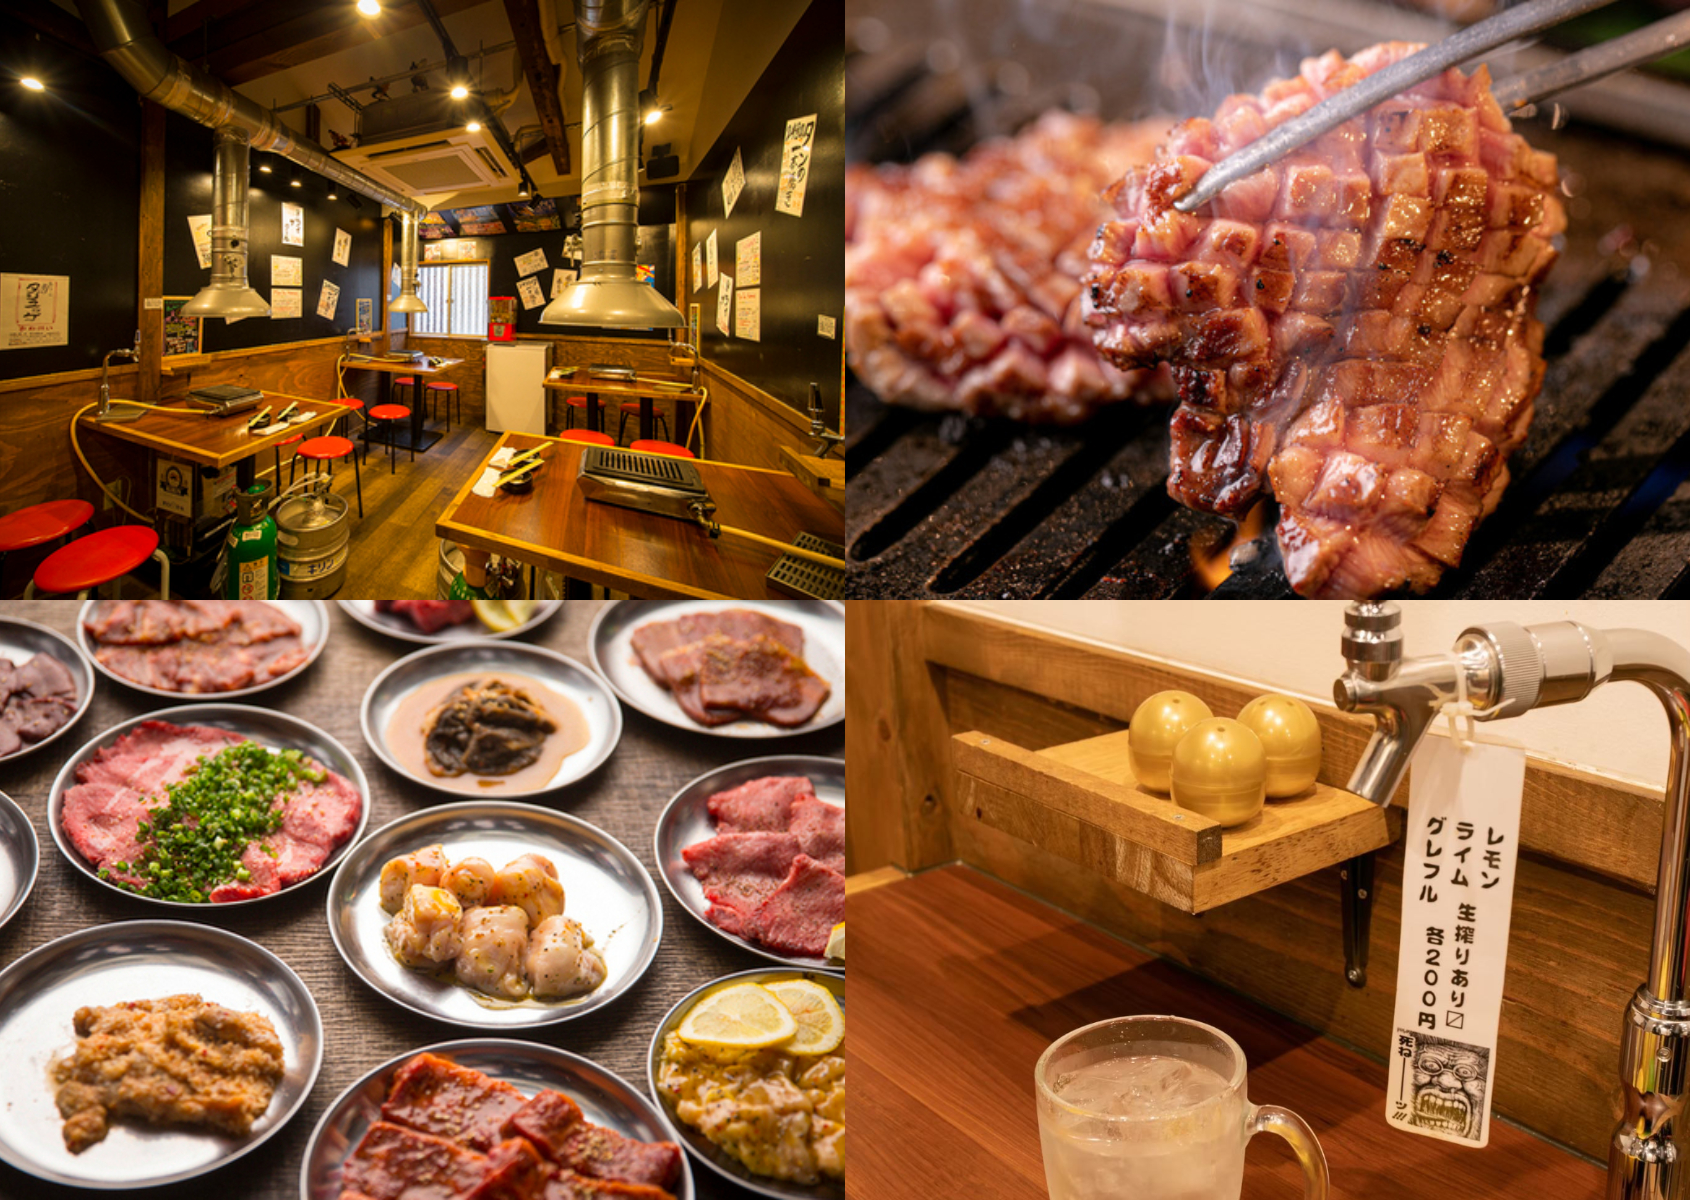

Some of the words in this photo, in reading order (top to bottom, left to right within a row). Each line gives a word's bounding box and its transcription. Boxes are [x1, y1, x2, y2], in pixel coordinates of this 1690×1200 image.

[307, 559, 334, 575] キリン
[1419, 817, 1446, 903] グレフル
[1450, 821, 1474, 887] ライム
[1480, 827, 1504, 889] レモン
[1418, 926, 1445, 1030] 各200円
